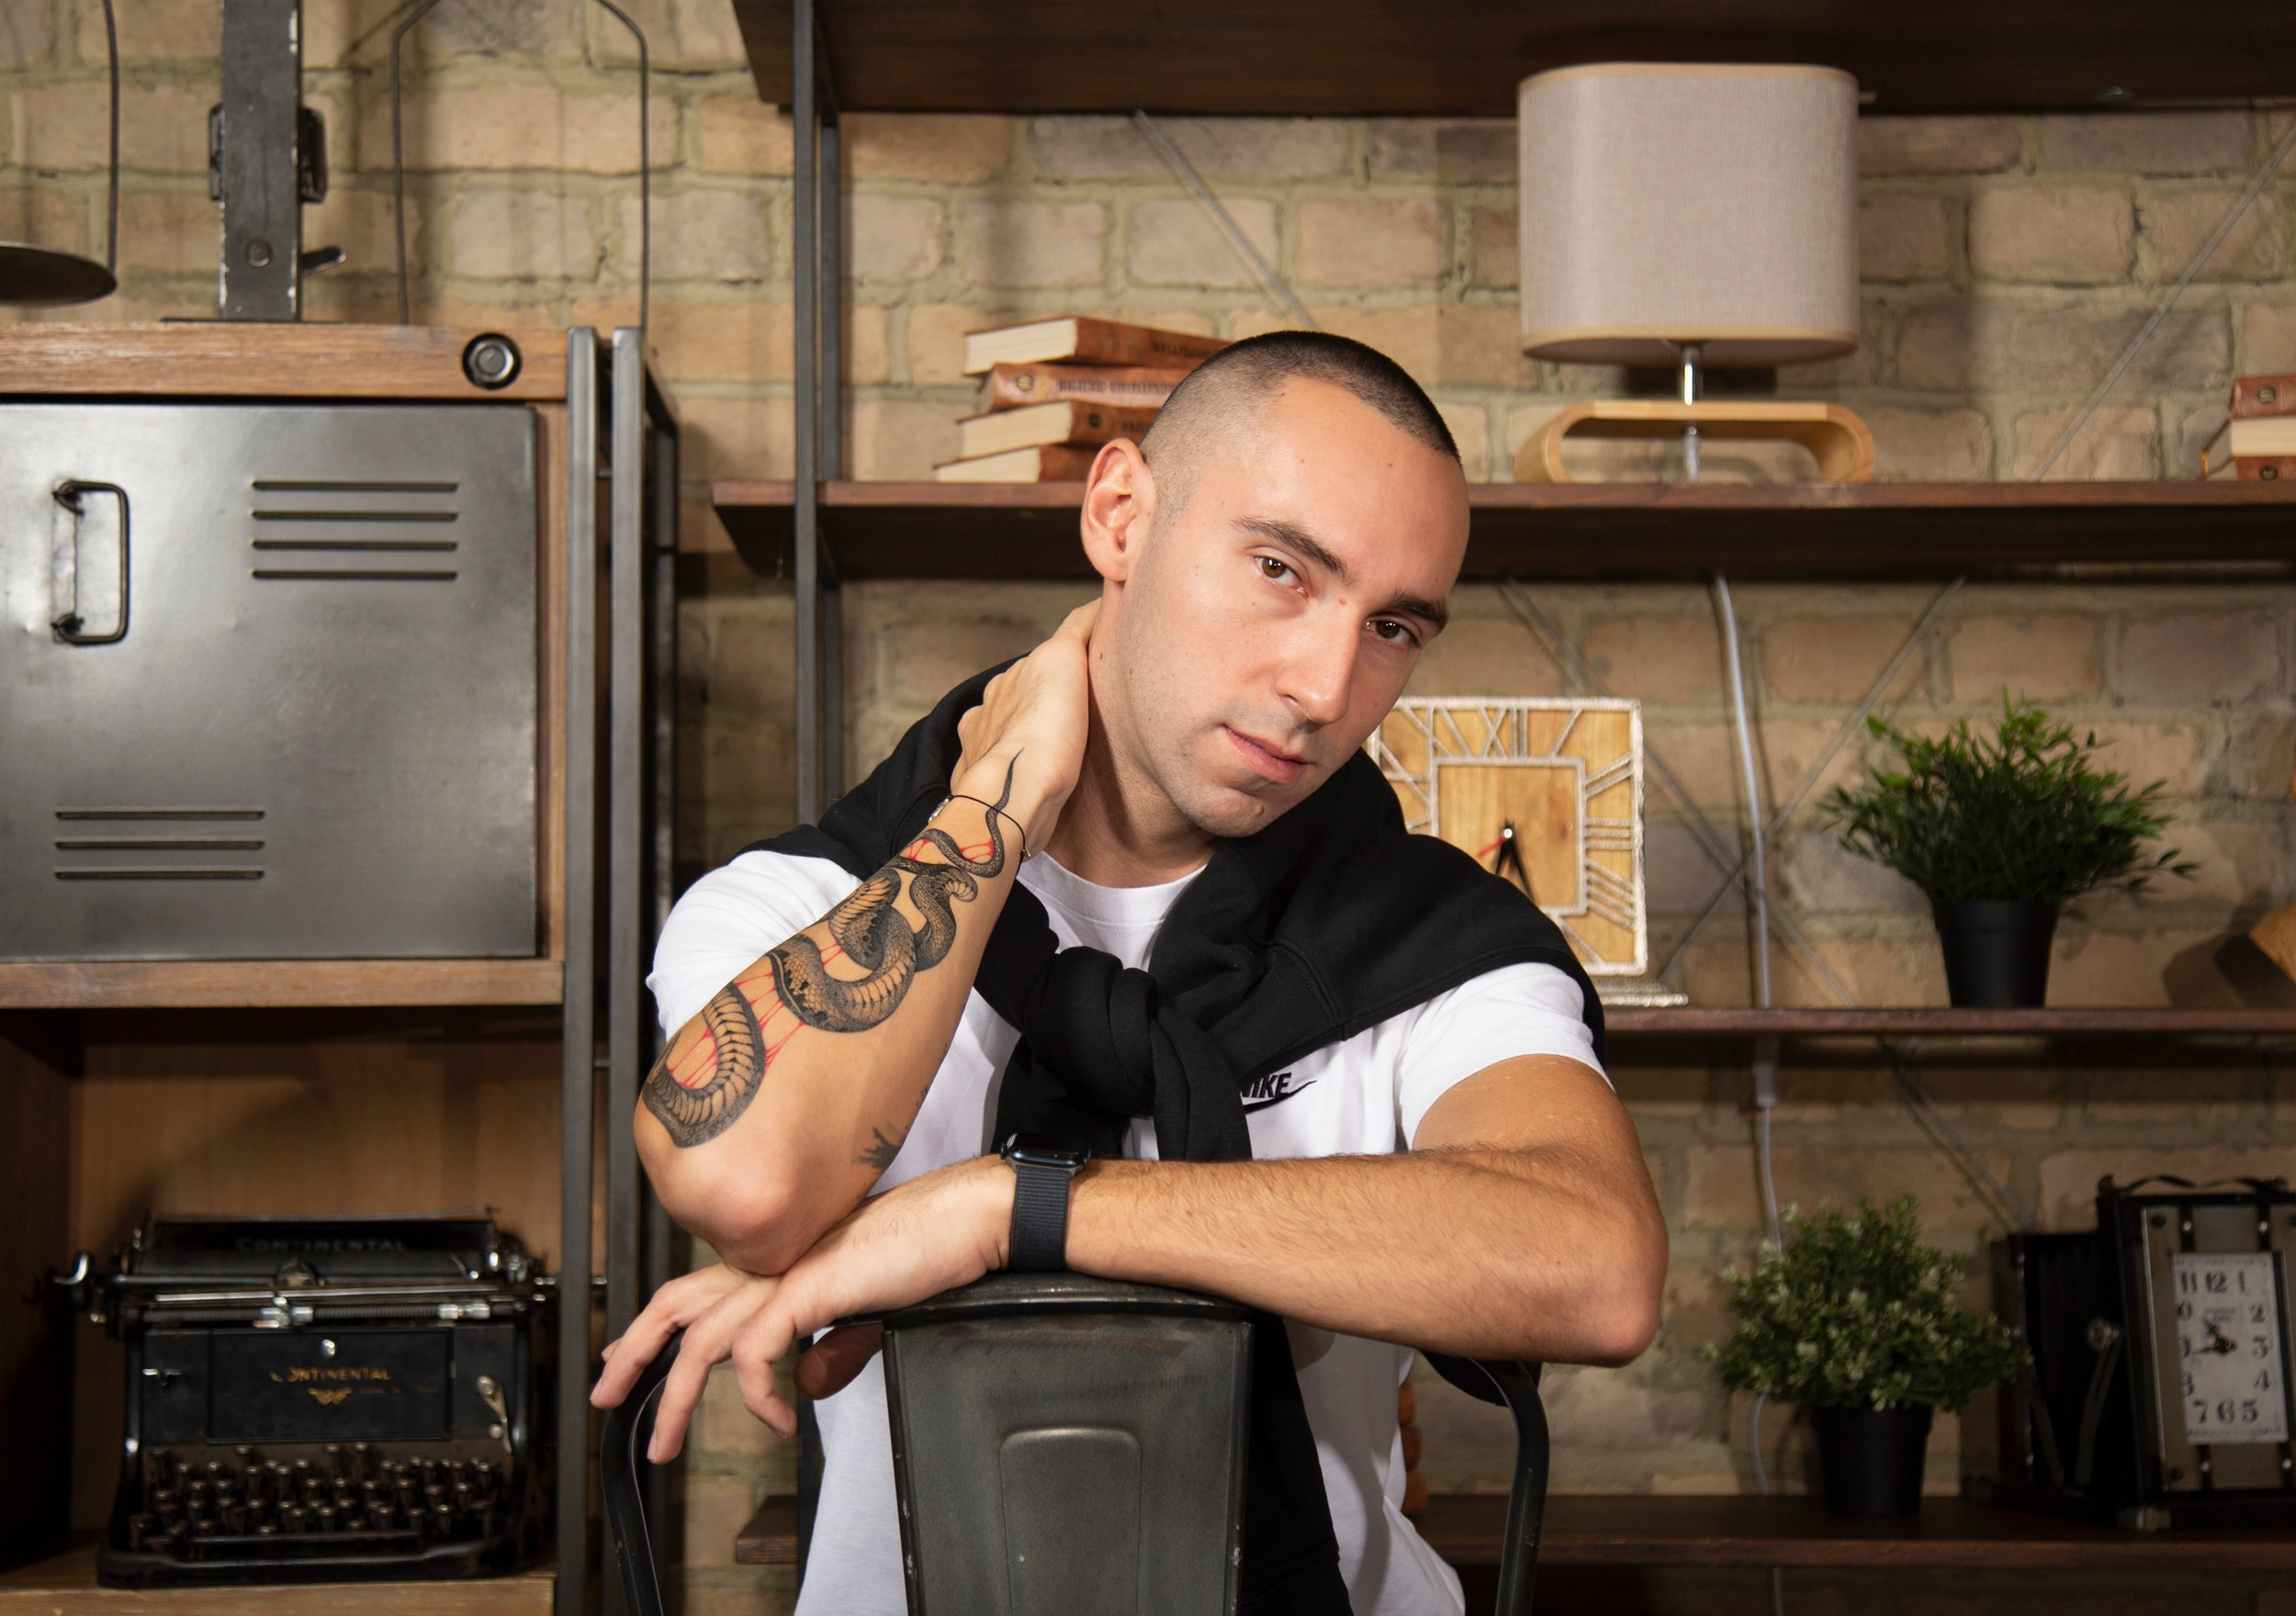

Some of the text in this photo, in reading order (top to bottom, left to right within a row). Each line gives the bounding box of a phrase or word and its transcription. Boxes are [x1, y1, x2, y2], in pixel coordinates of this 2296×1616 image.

[235, 1235, 407, 1252] CONTINENTAL
[2179, 1269, 2246, 1295] 11 12 1
[2250, 1302, 2266, 1323] 2
[2252, 1335, 2268, 1360] 3
[2254, 1369, 2271, 1392] 4
[2193, 1397, 2259, 1424] 7 6 5
